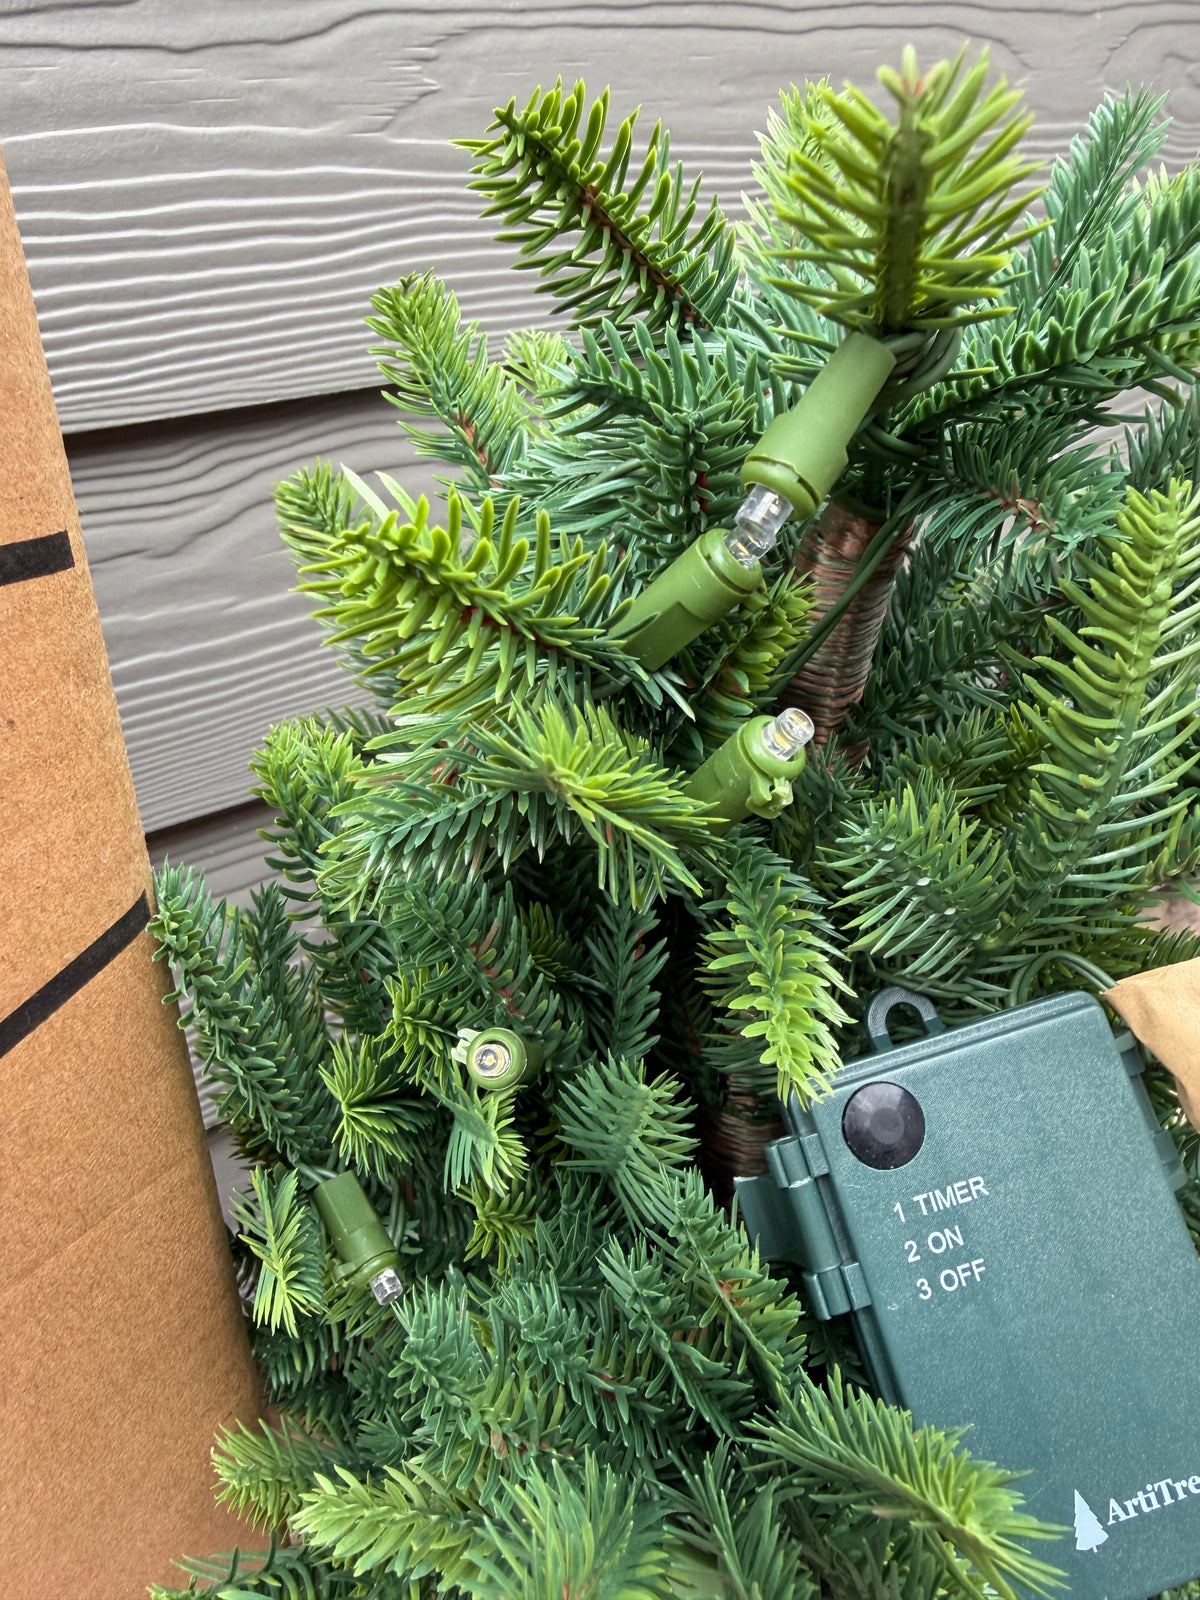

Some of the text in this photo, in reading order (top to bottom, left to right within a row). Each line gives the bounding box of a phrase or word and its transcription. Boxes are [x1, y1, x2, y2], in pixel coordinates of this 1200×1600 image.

[893, 1176, 990, 1223] 1 TIMER
[904, 1225, 964, 1263] 2 ON
[916, 1258, 986, 1300] 3 OFF
